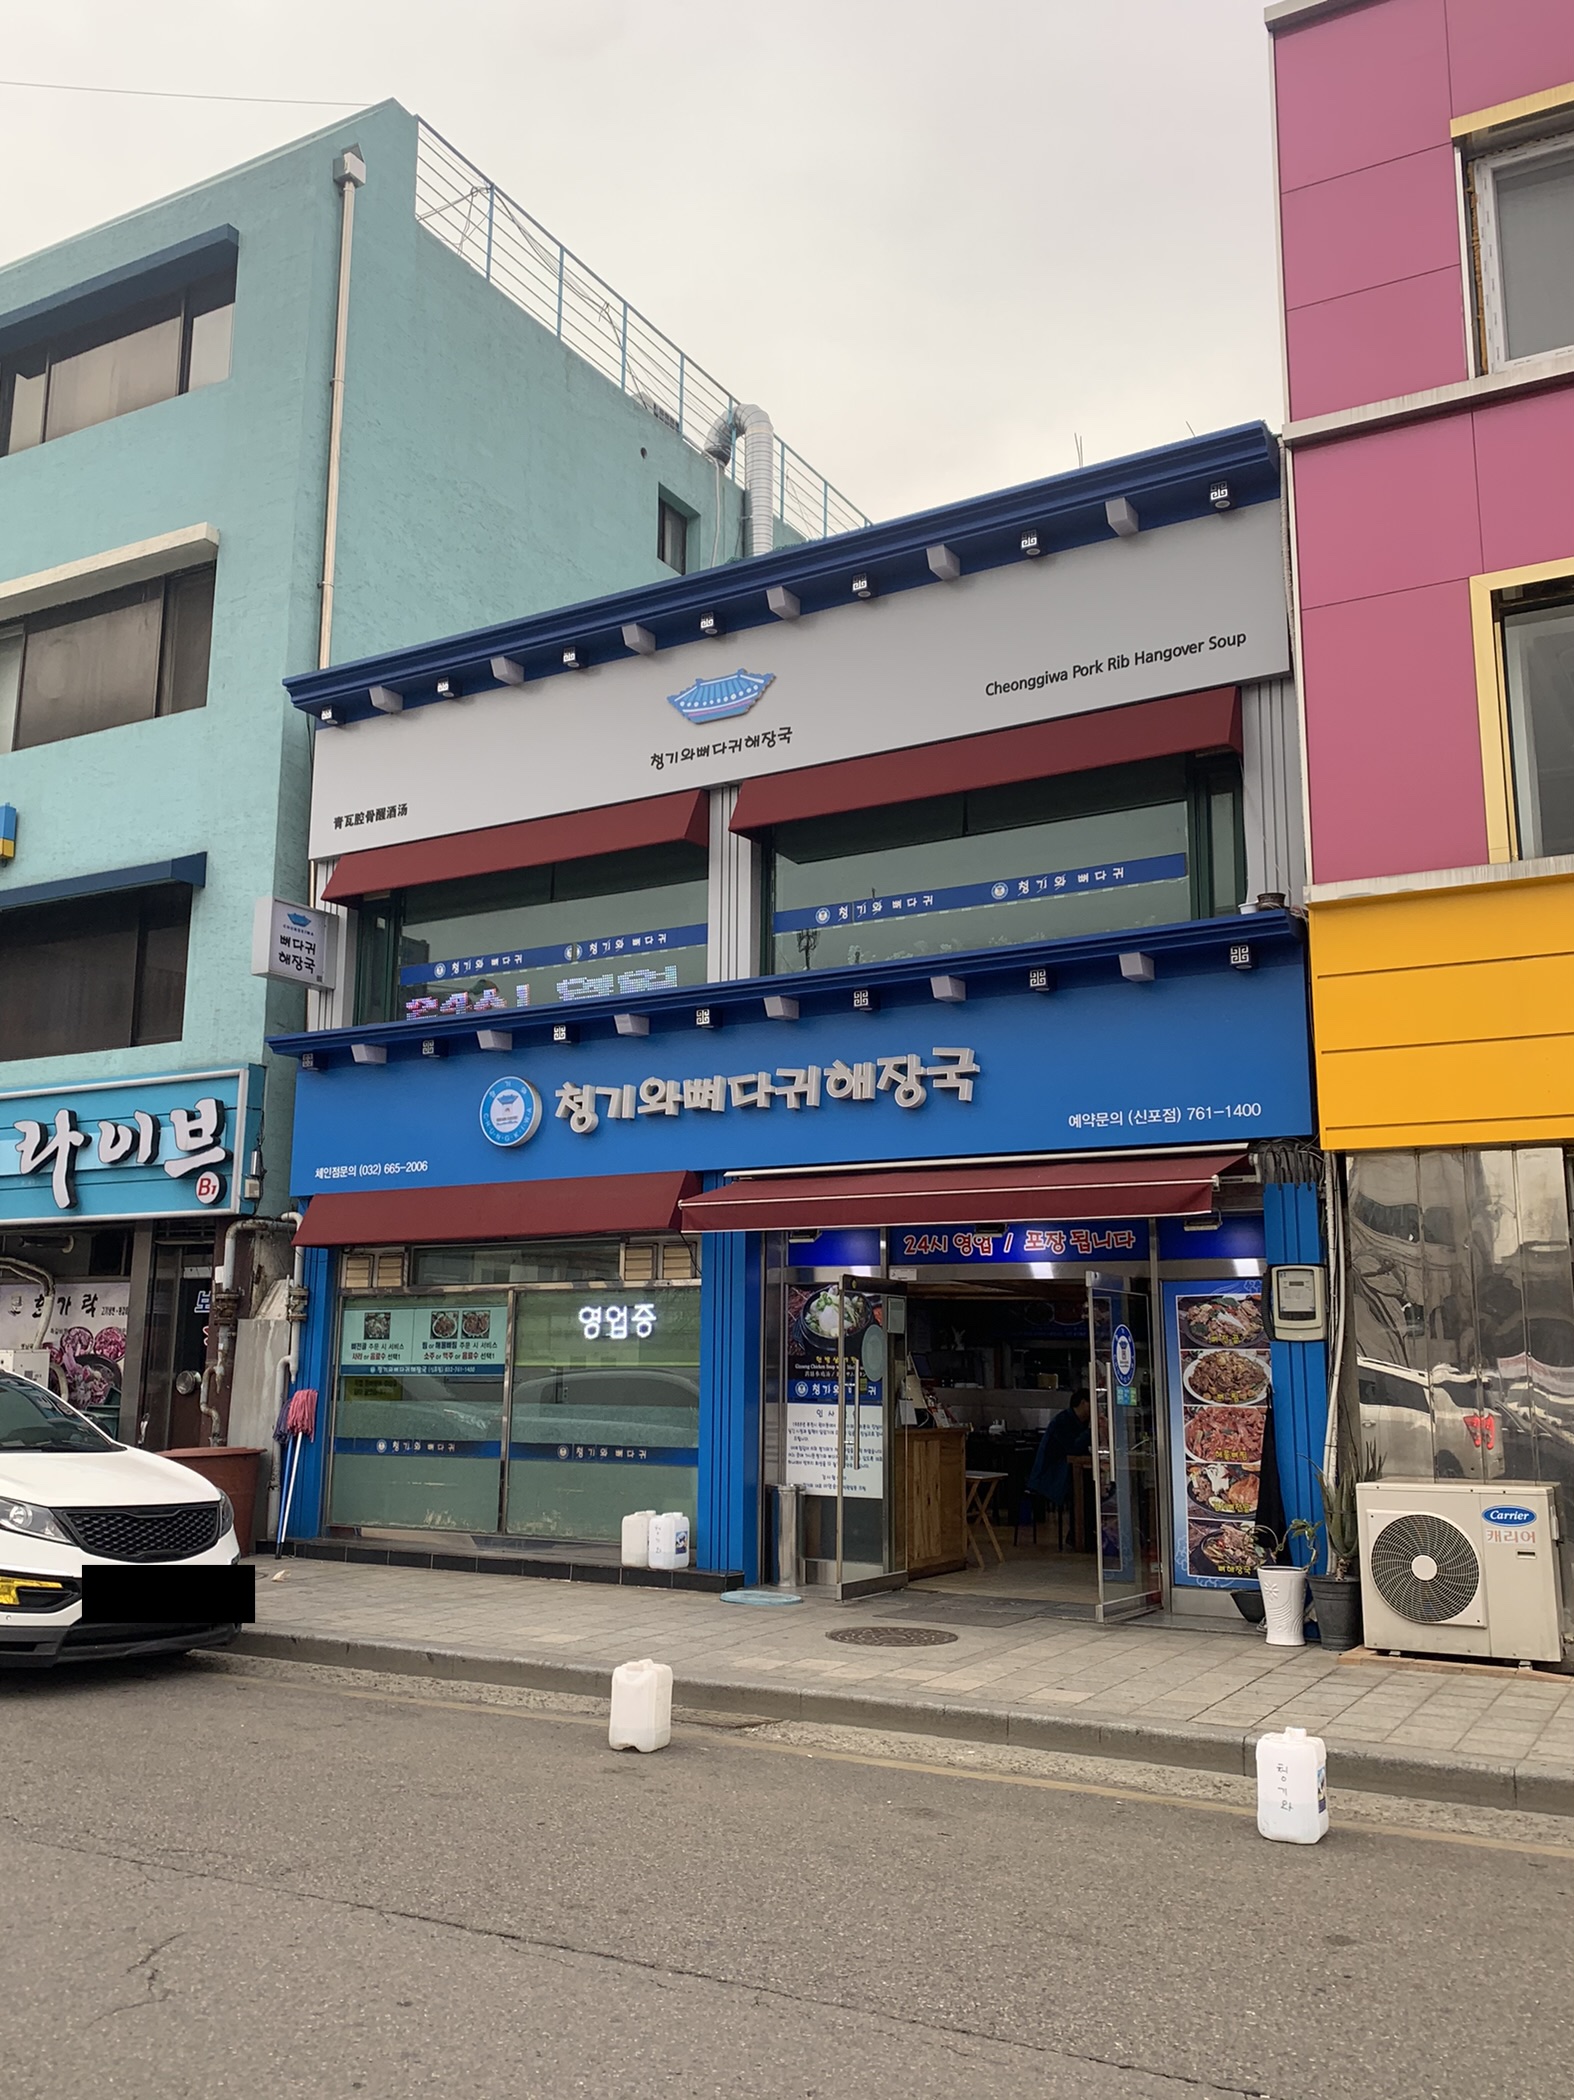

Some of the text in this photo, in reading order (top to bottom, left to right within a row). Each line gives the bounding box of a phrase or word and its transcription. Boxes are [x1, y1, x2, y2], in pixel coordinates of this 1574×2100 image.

[985, 632, 1247, 696] Cheonggiwa Pork Rib Hangover Soup
[650, 726, 793, 770] 청기와뼈다귀해장국
[280, 935, 316, 955] 뼈다귀
[278, 951, 316, 974] 해장국
[554, 1047, 980, 1134] 청기와뼈다귀해장국
[1068, 1102, 1262, 1128] 예약문의 (신포점) 761-1400
[13, 1097, 229, 1210] 라이브
[315, 1160, 428, 1179] 체인점문의 (032) 665-2006
[198, 1177, 218, 1196] B1
[903, 1234, 949, 1255] 24시
[952, 1232, 993, 1257] 영업
[1024, 1230, 1066, 1254] 포장
[1070, 1229, 1136, 1254] 됩니다
[578, 1303, 657, 1340] 영업중
[1490, 1510, 1530, 1521] Carrier
[1486, 1530, 1536, 1544] 캐리어
